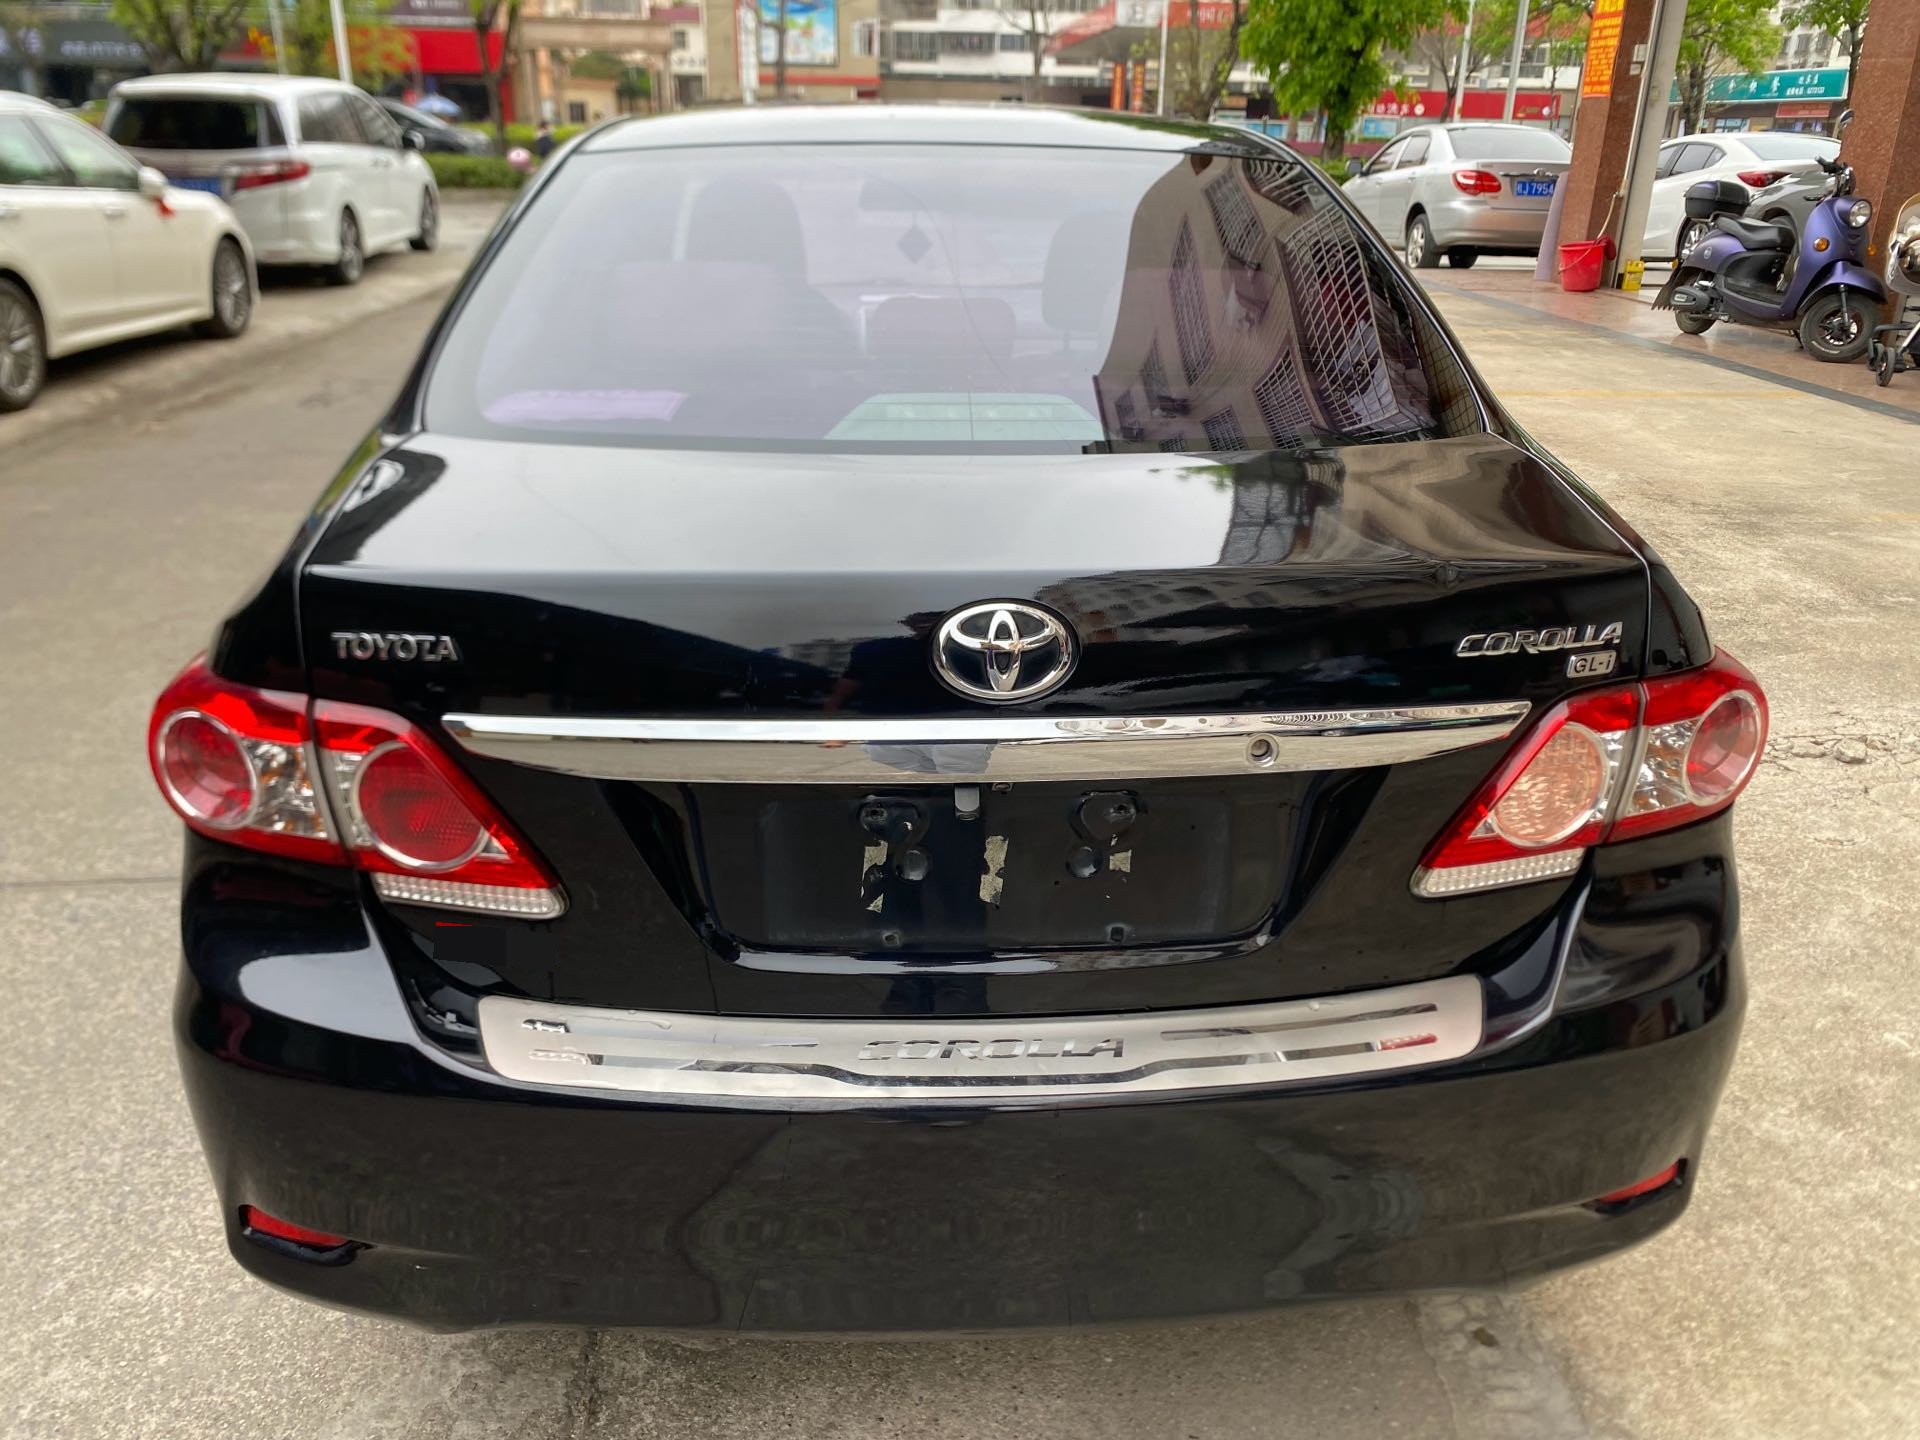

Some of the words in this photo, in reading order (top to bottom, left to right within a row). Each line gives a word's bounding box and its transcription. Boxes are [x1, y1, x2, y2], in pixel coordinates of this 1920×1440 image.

[331, 632, 458, 662] TOYOTA
[1456, 621, 1623, 657] COROLLA
[1574, 654, 1613, 674] GL-i
[858, 1038, 1125, 1061] COROLLA
